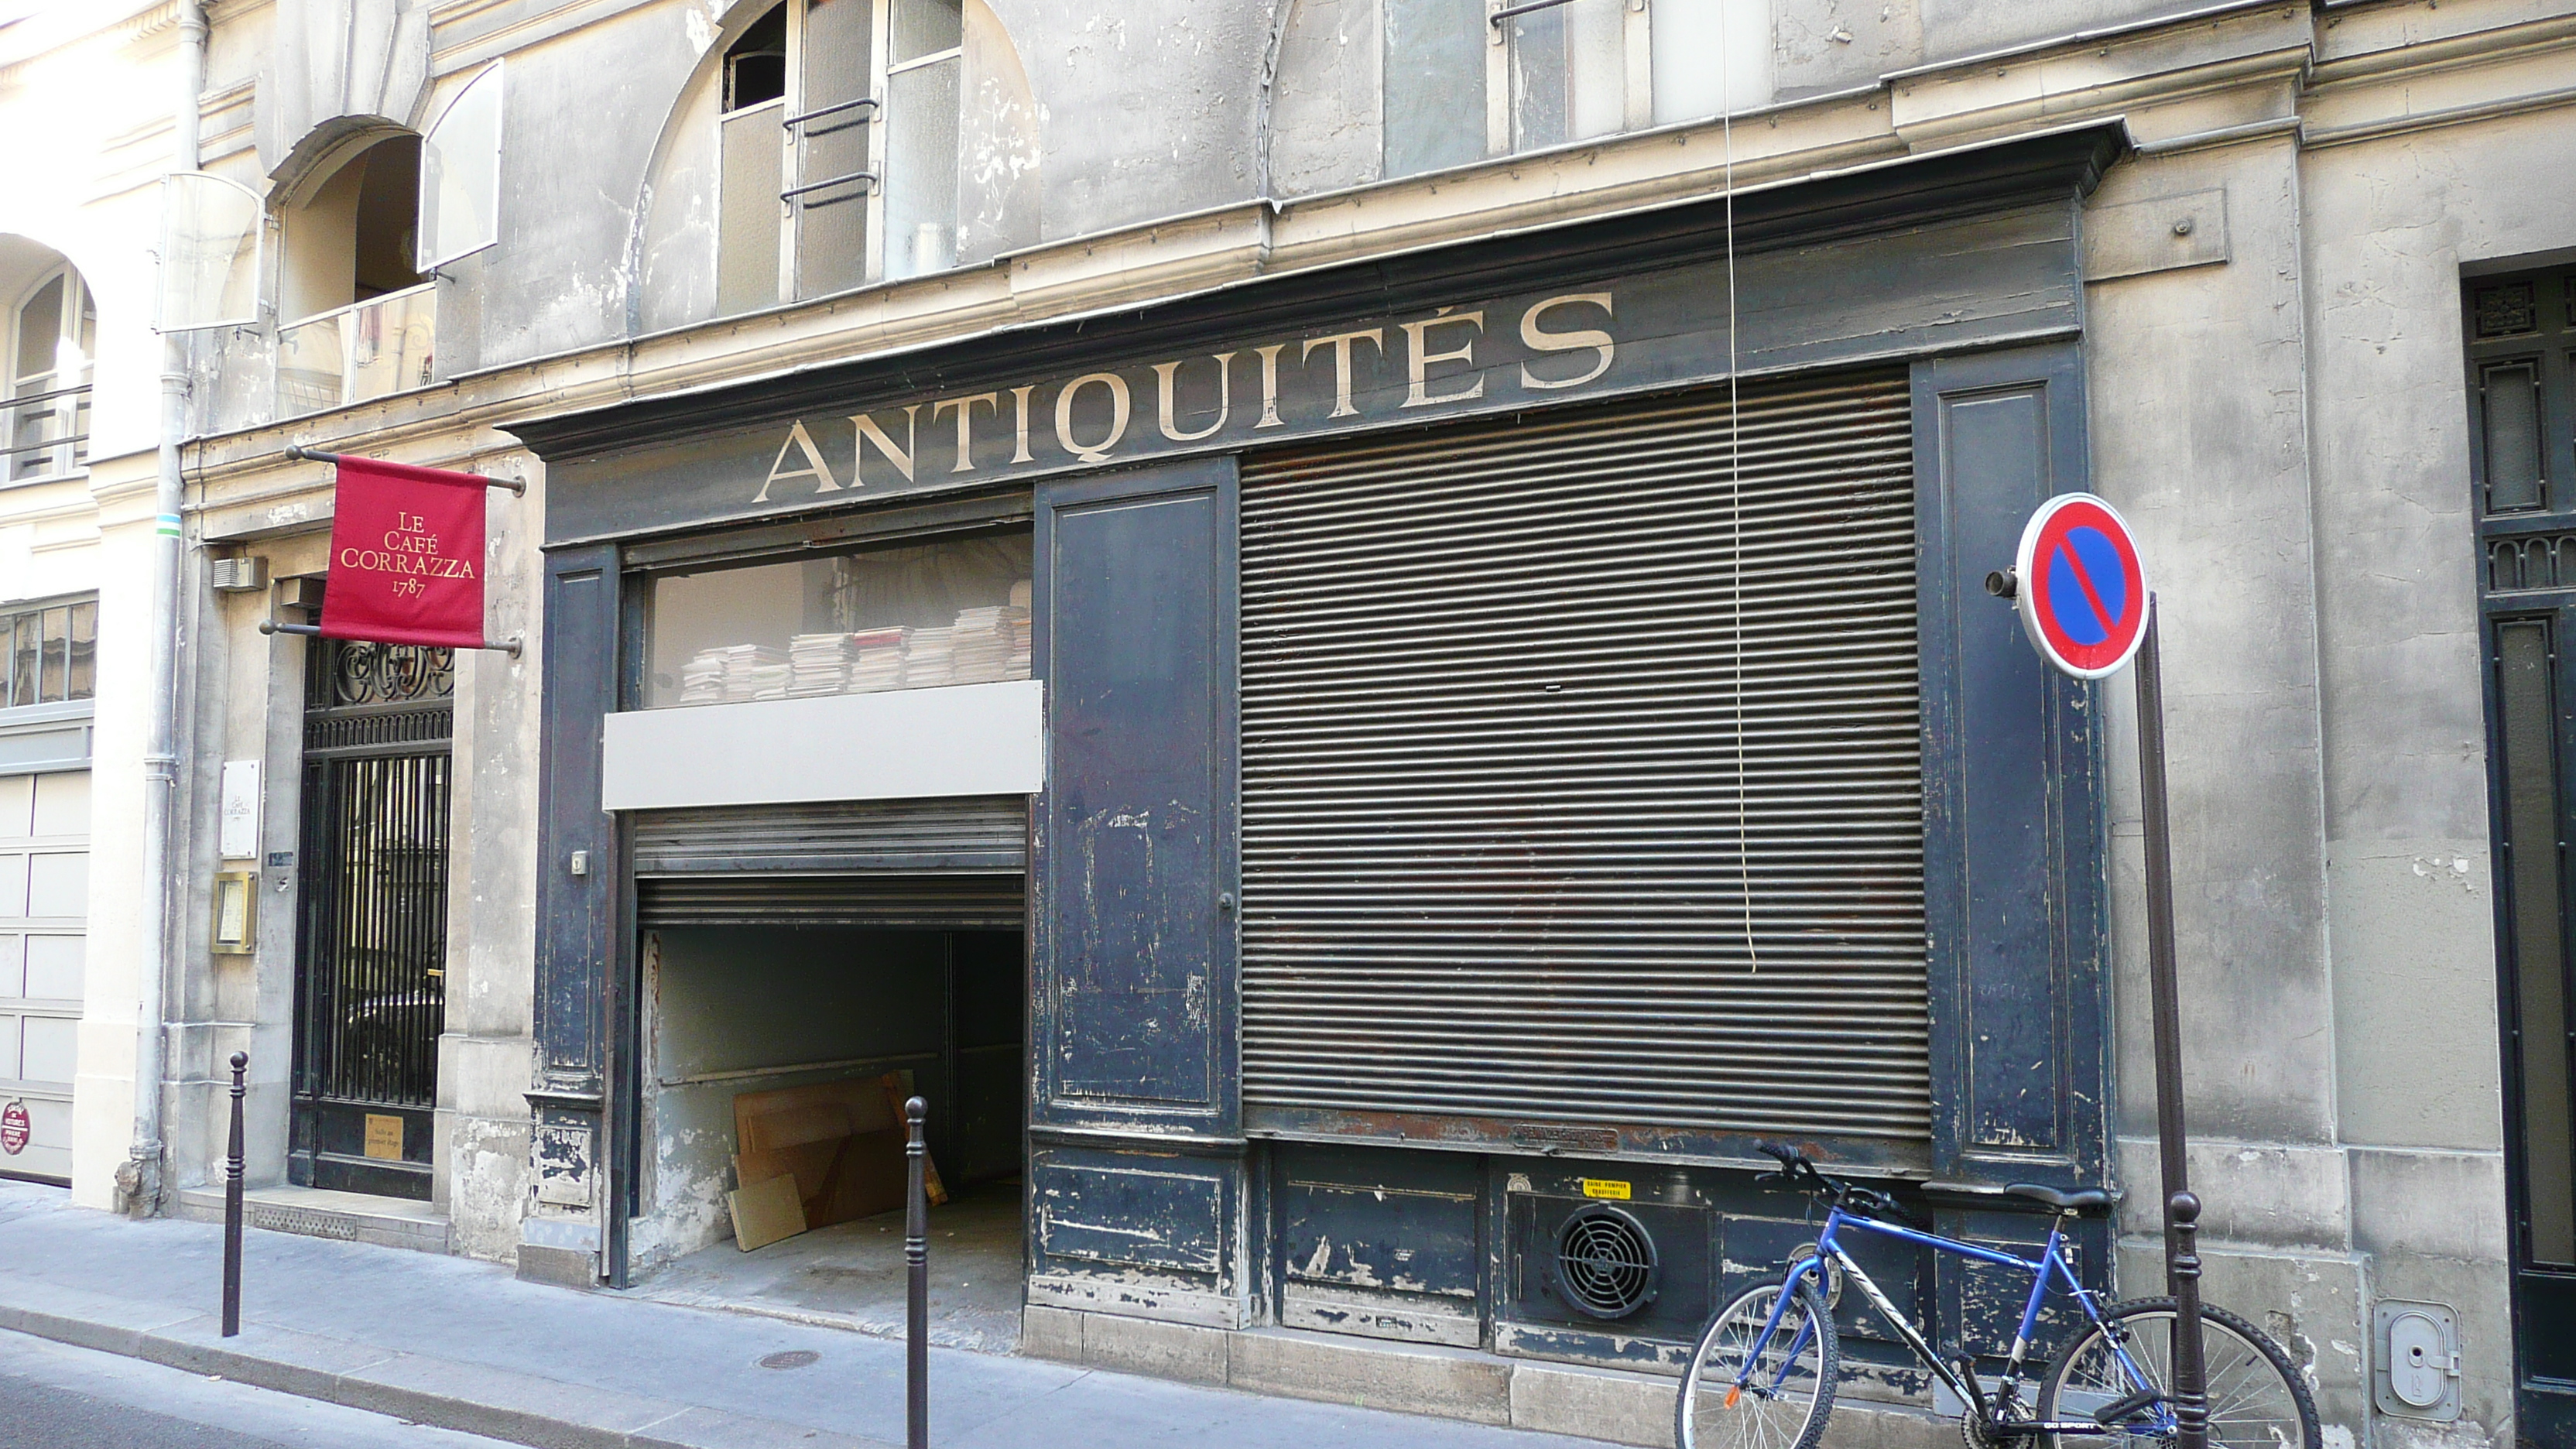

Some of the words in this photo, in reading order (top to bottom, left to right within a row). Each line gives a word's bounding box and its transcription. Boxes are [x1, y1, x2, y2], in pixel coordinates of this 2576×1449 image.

[752, 291, 1615, 504] ANTIQUITÉS
[398, 512, 424, 533] LE
[384, 531, 438, 554] CAFÉ
[341, 548, 475, 579] CORRAZZA
[392, 578, 425, 598] 1787
